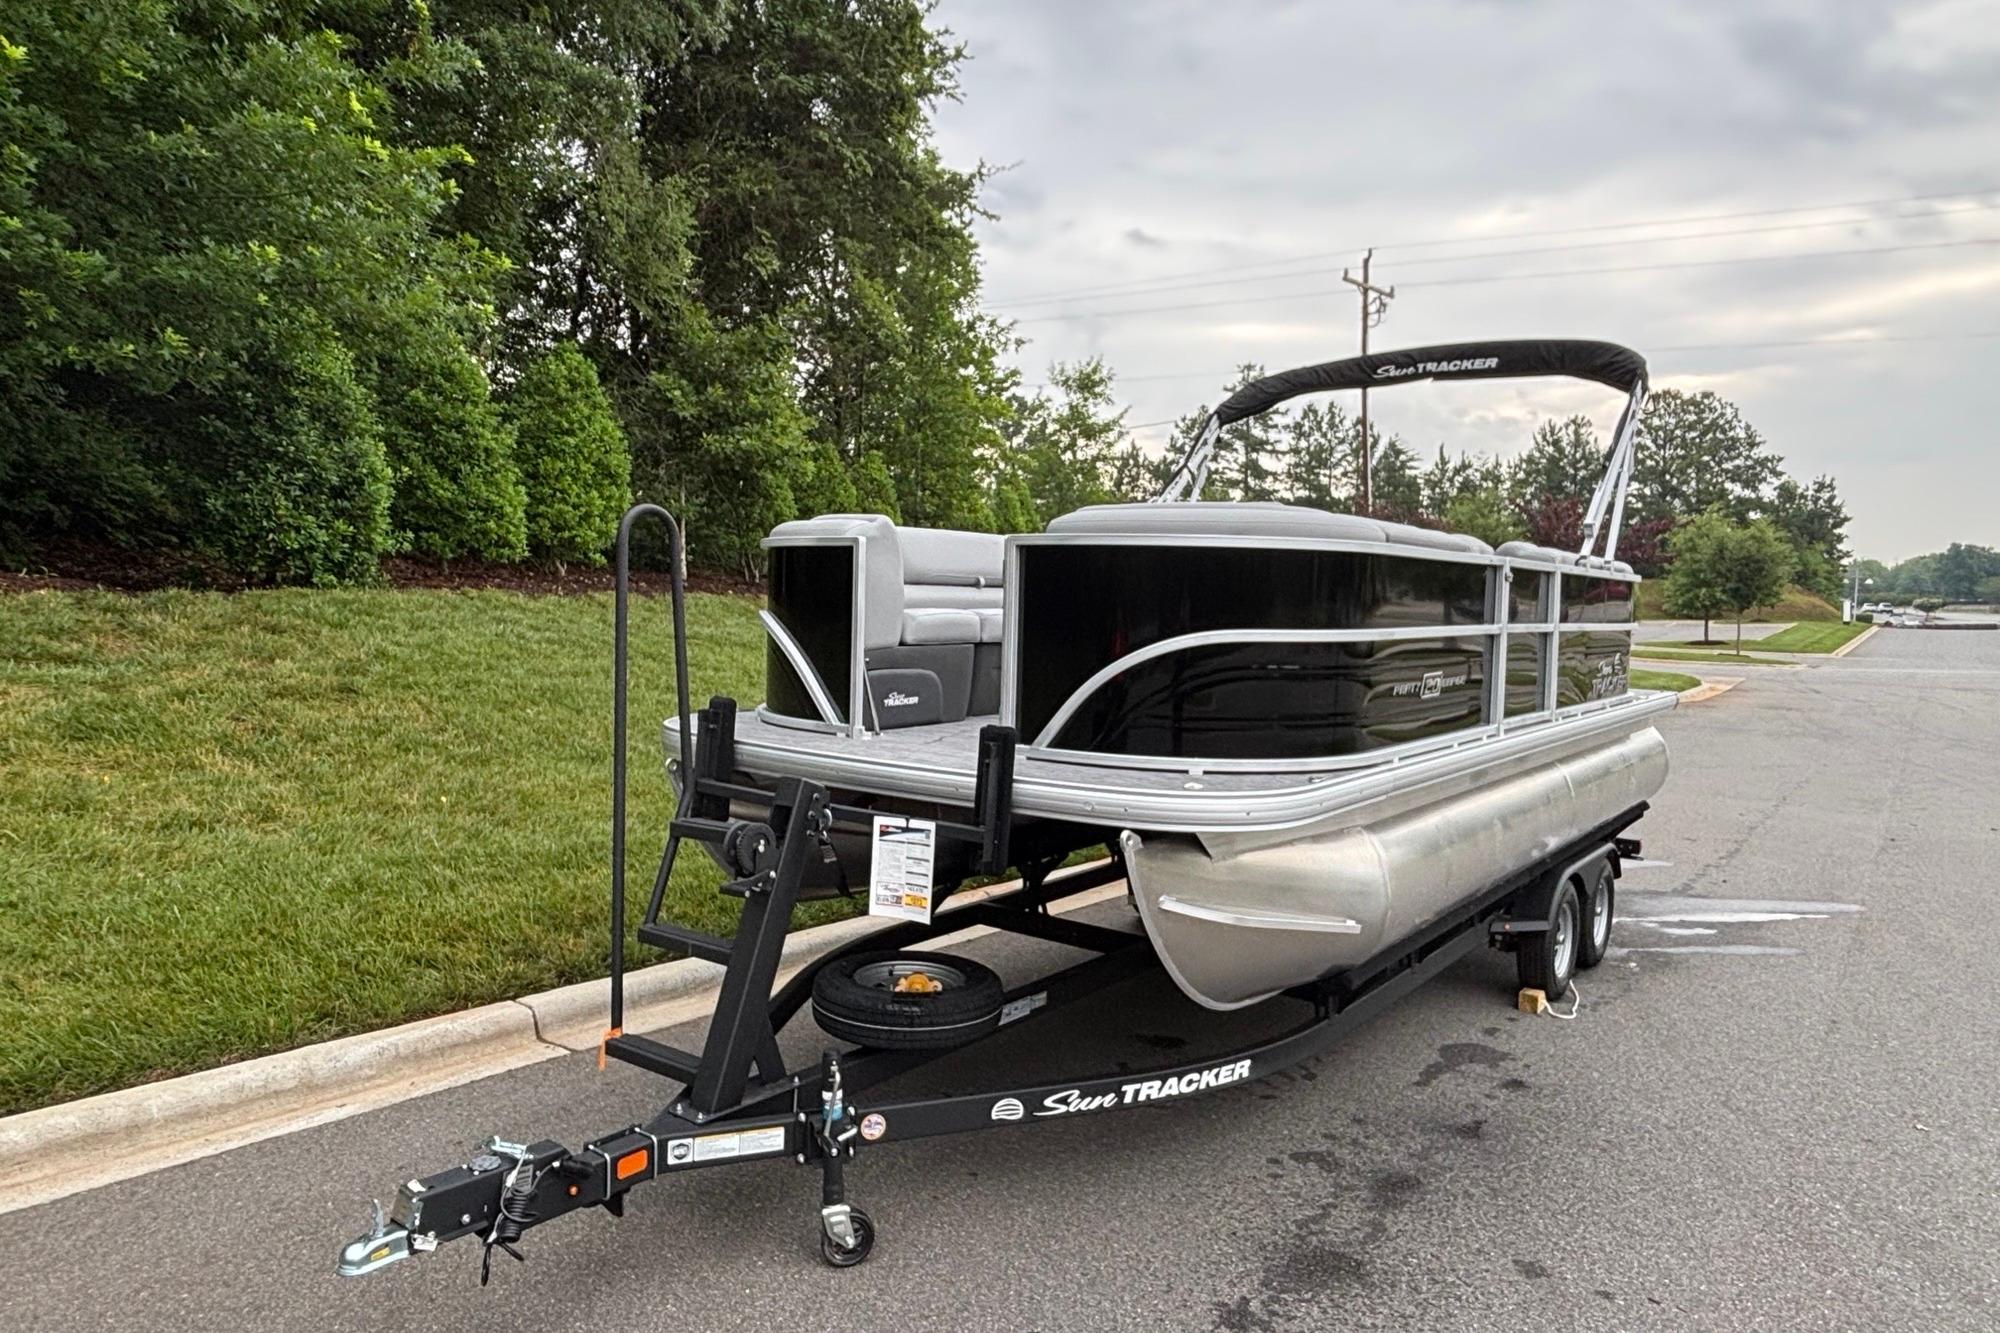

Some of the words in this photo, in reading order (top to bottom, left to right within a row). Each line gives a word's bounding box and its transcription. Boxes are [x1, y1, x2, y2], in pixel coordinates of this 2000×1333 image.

[1373, 365, 1416, 379] Sun
[1416, 357, 1499, 374] TRACKER
[883, 696, 919, 707] TRACKER
[1032, 1089, 1118, 1116] Sun
[1121, 1059, 1252, 1104] TRACKER
